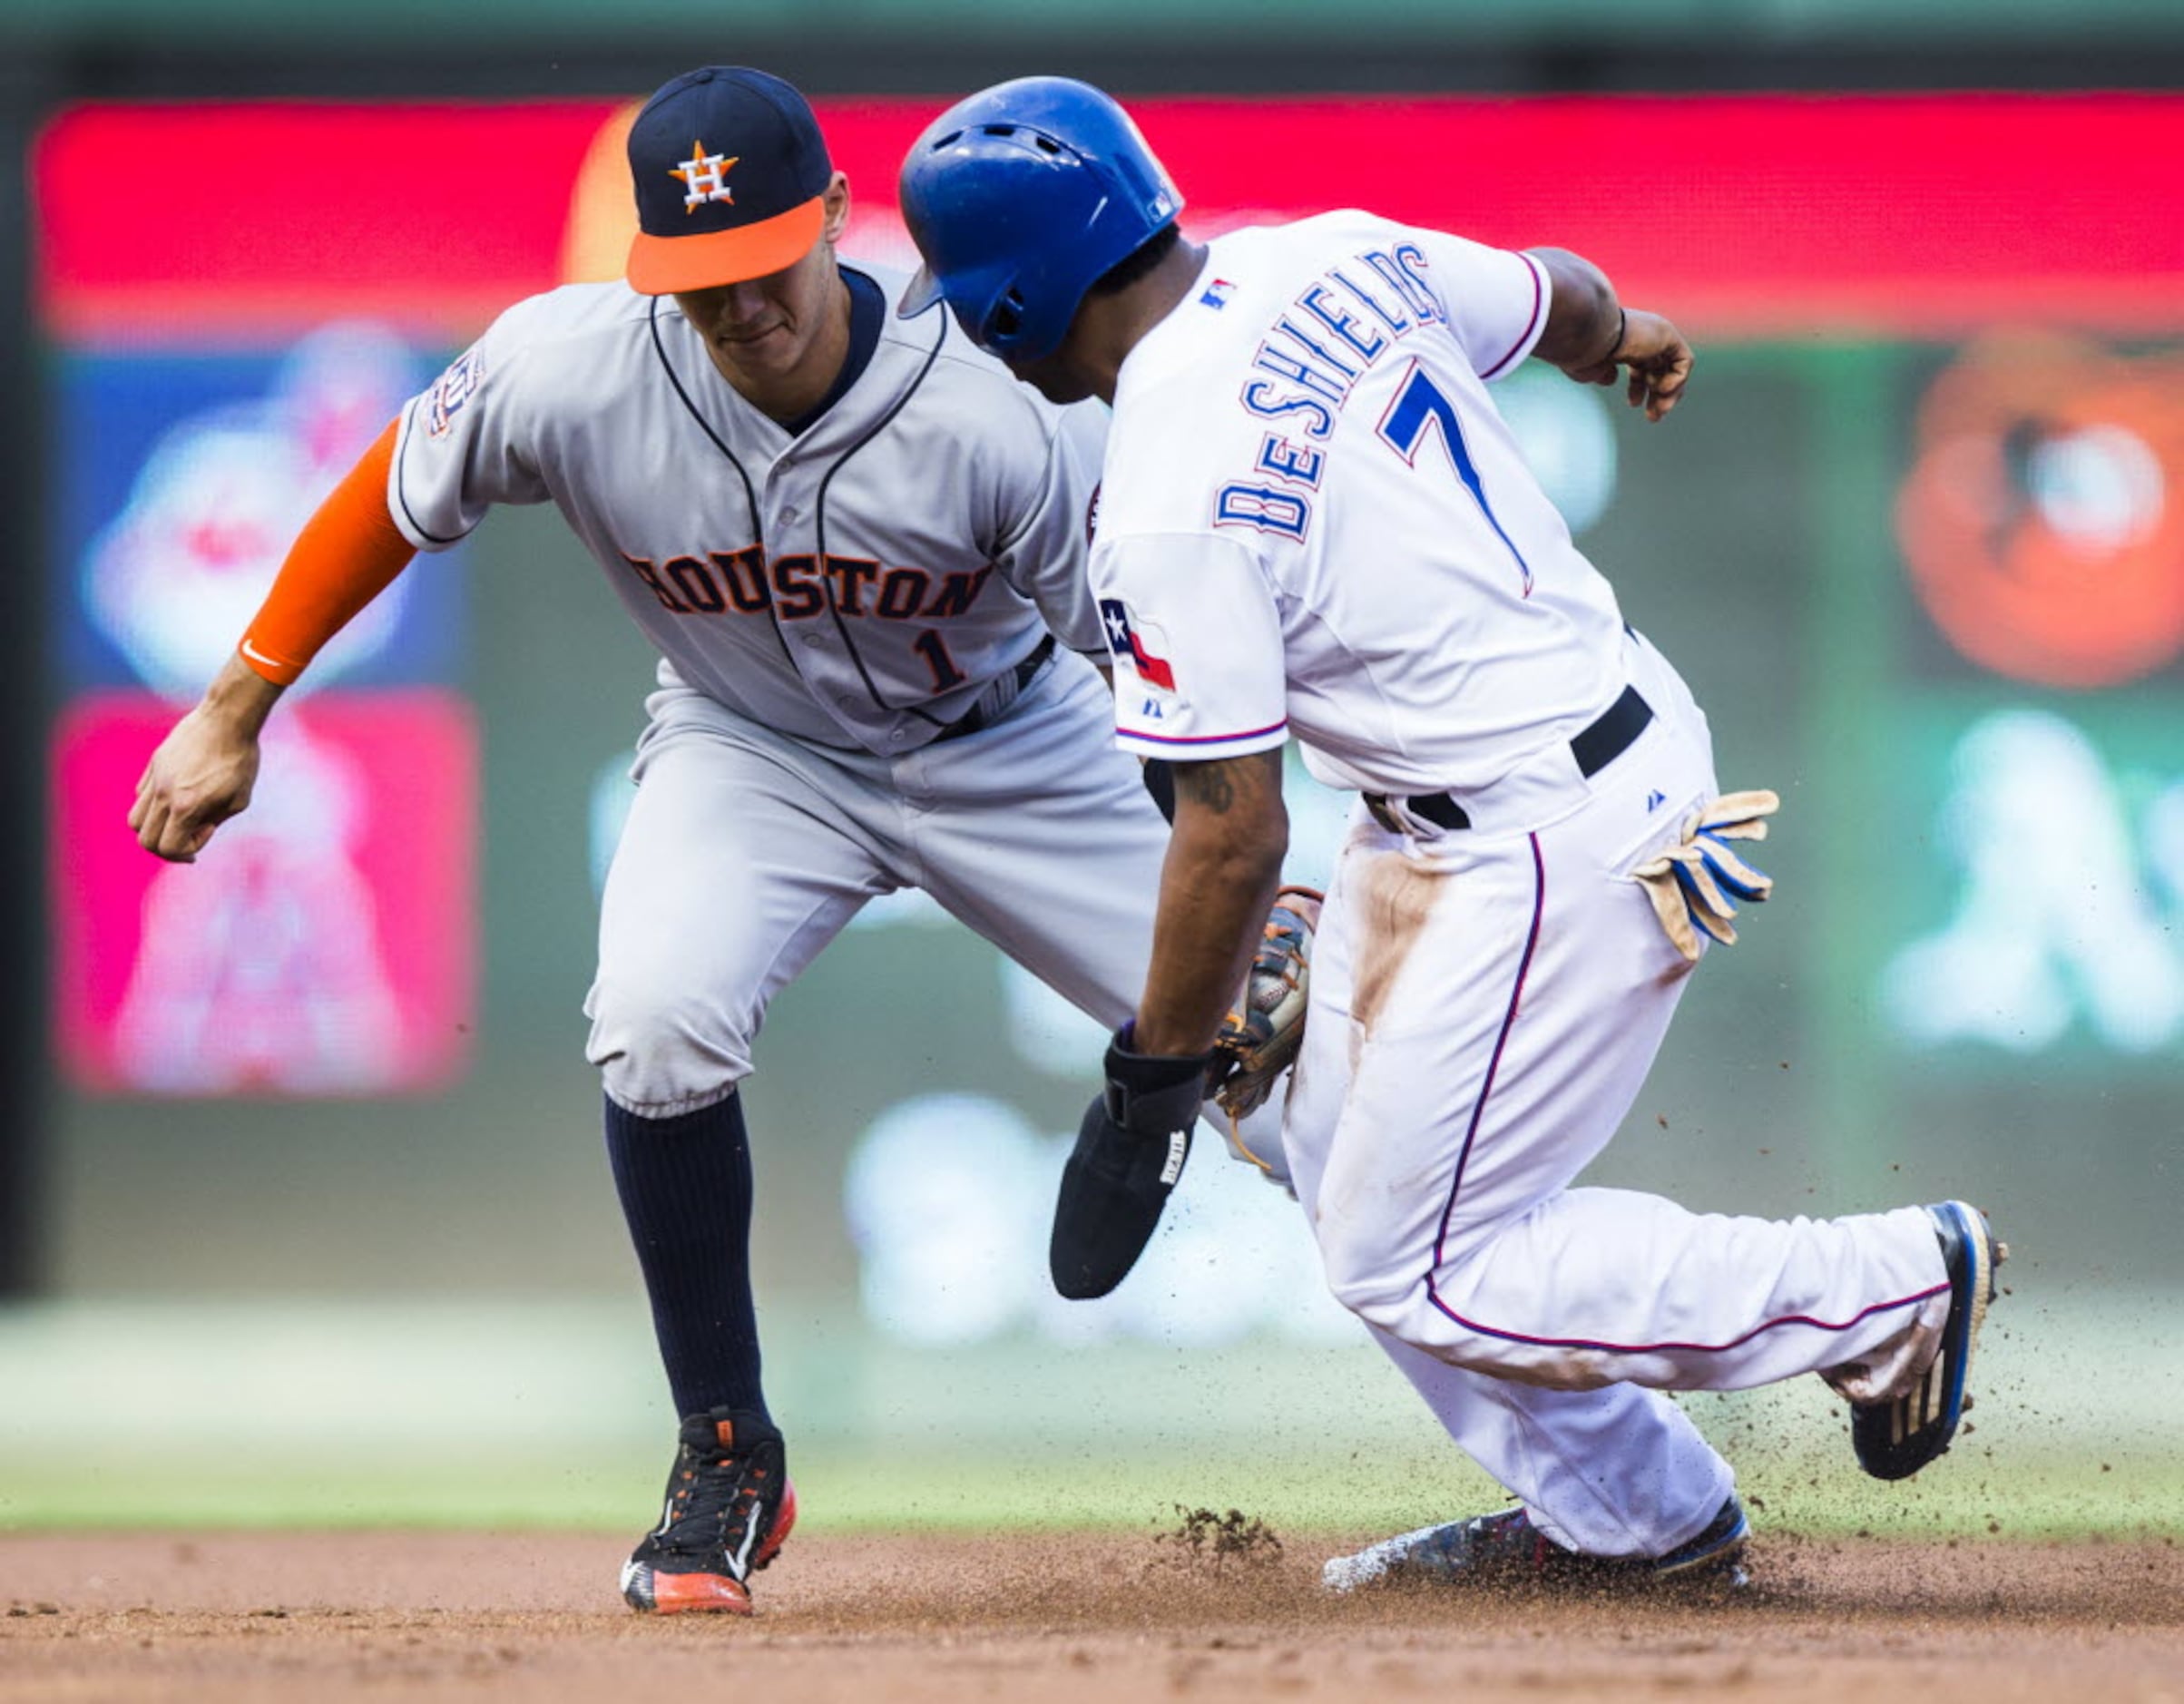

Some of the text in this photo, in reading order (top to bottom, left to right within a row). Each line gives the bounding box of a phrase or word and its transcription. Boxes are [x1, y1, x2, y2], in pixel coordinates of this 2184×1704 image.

[677, 152, 731, 205] H
[1376, 355, 1533, 599] 7
[621, 543, 994, 621] HOUSTON
[914, 630, 965, 694] 1
